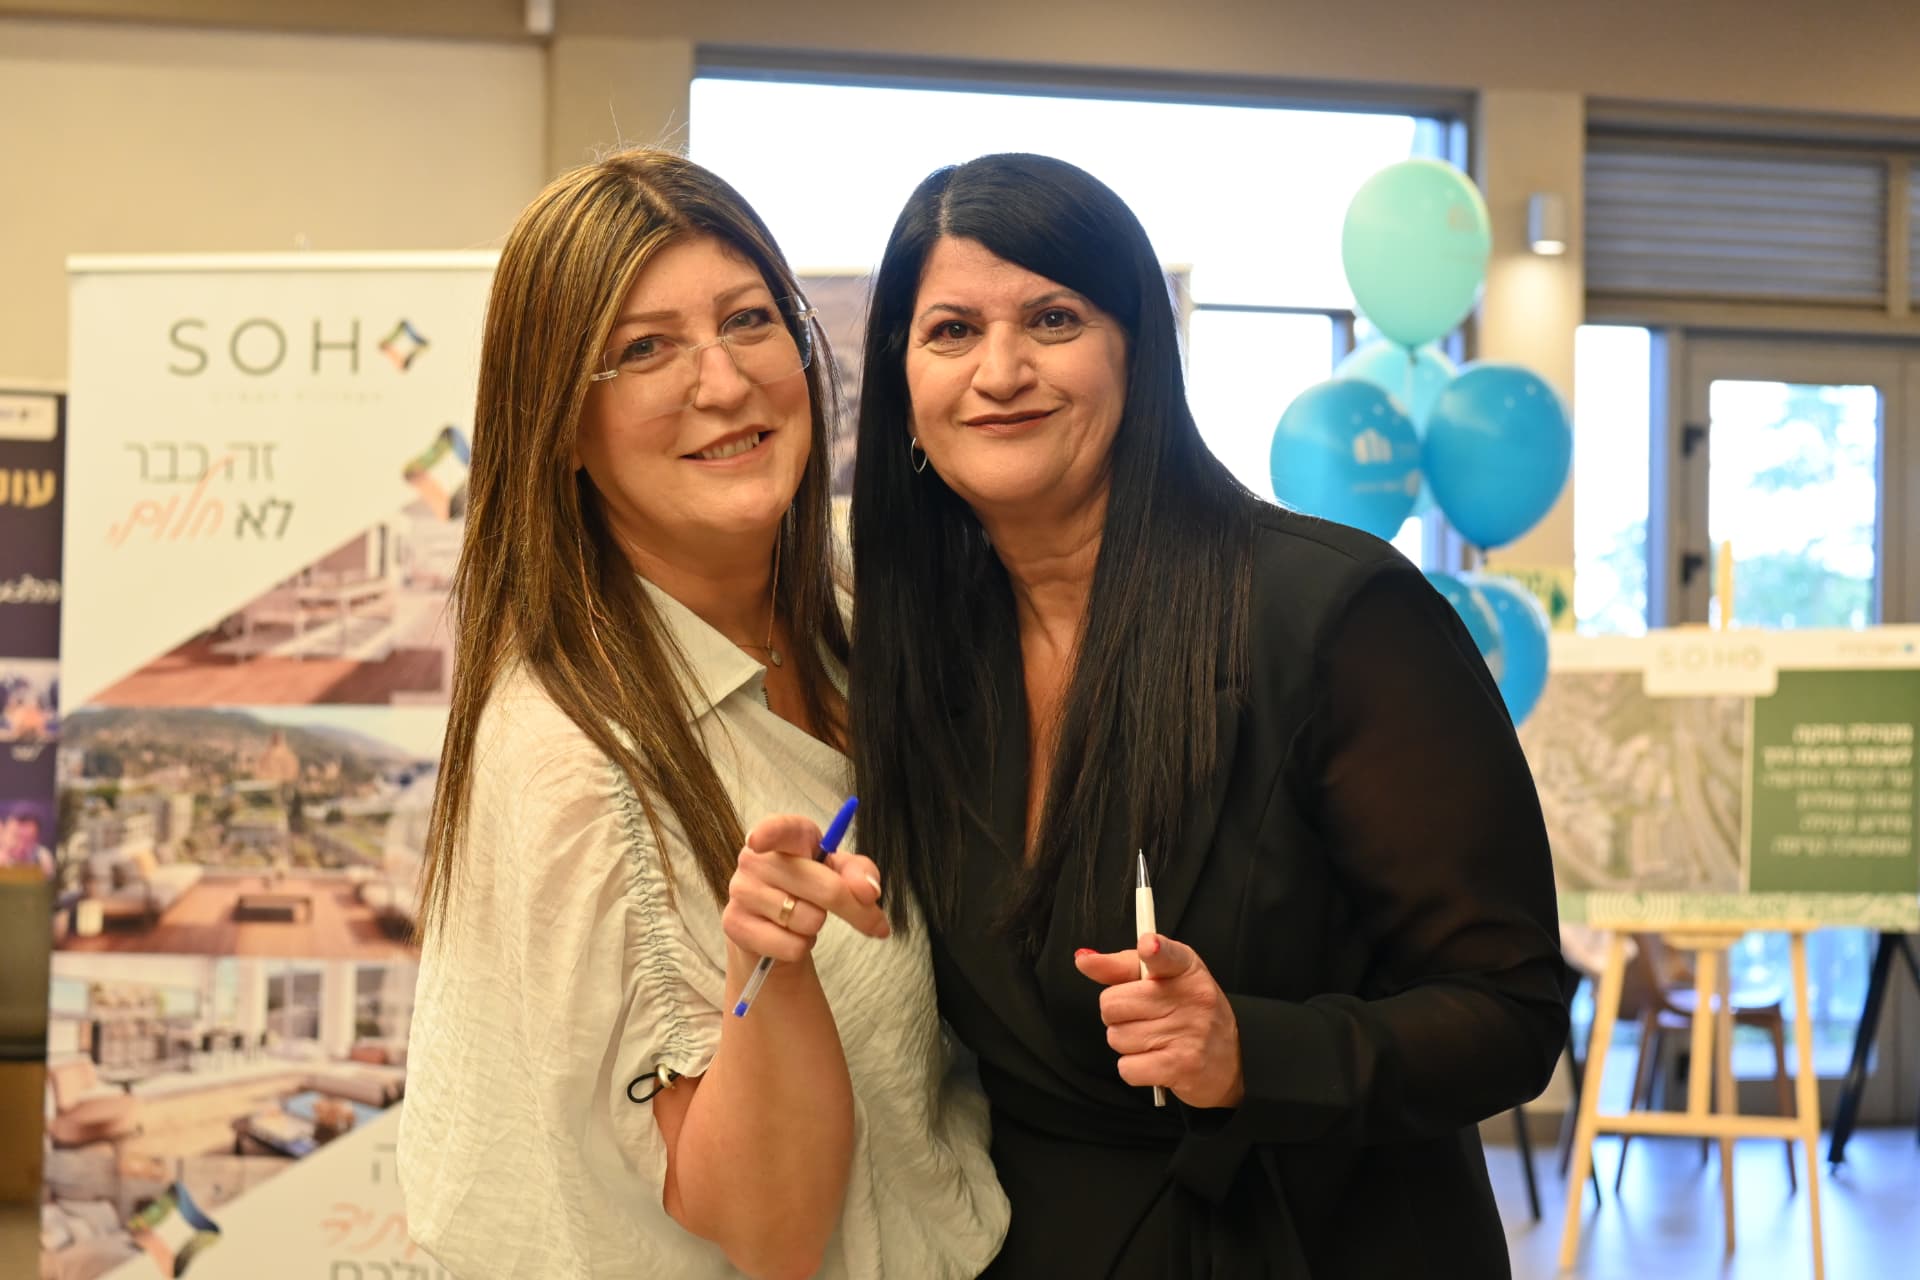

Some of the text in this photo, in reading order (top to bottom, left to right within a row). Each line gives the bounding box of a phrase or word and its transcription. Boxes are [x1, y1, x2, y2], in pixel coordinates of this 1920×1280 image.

[123, 441, 278, 483] זה כבר
[235, 495, 293, 540] לא
